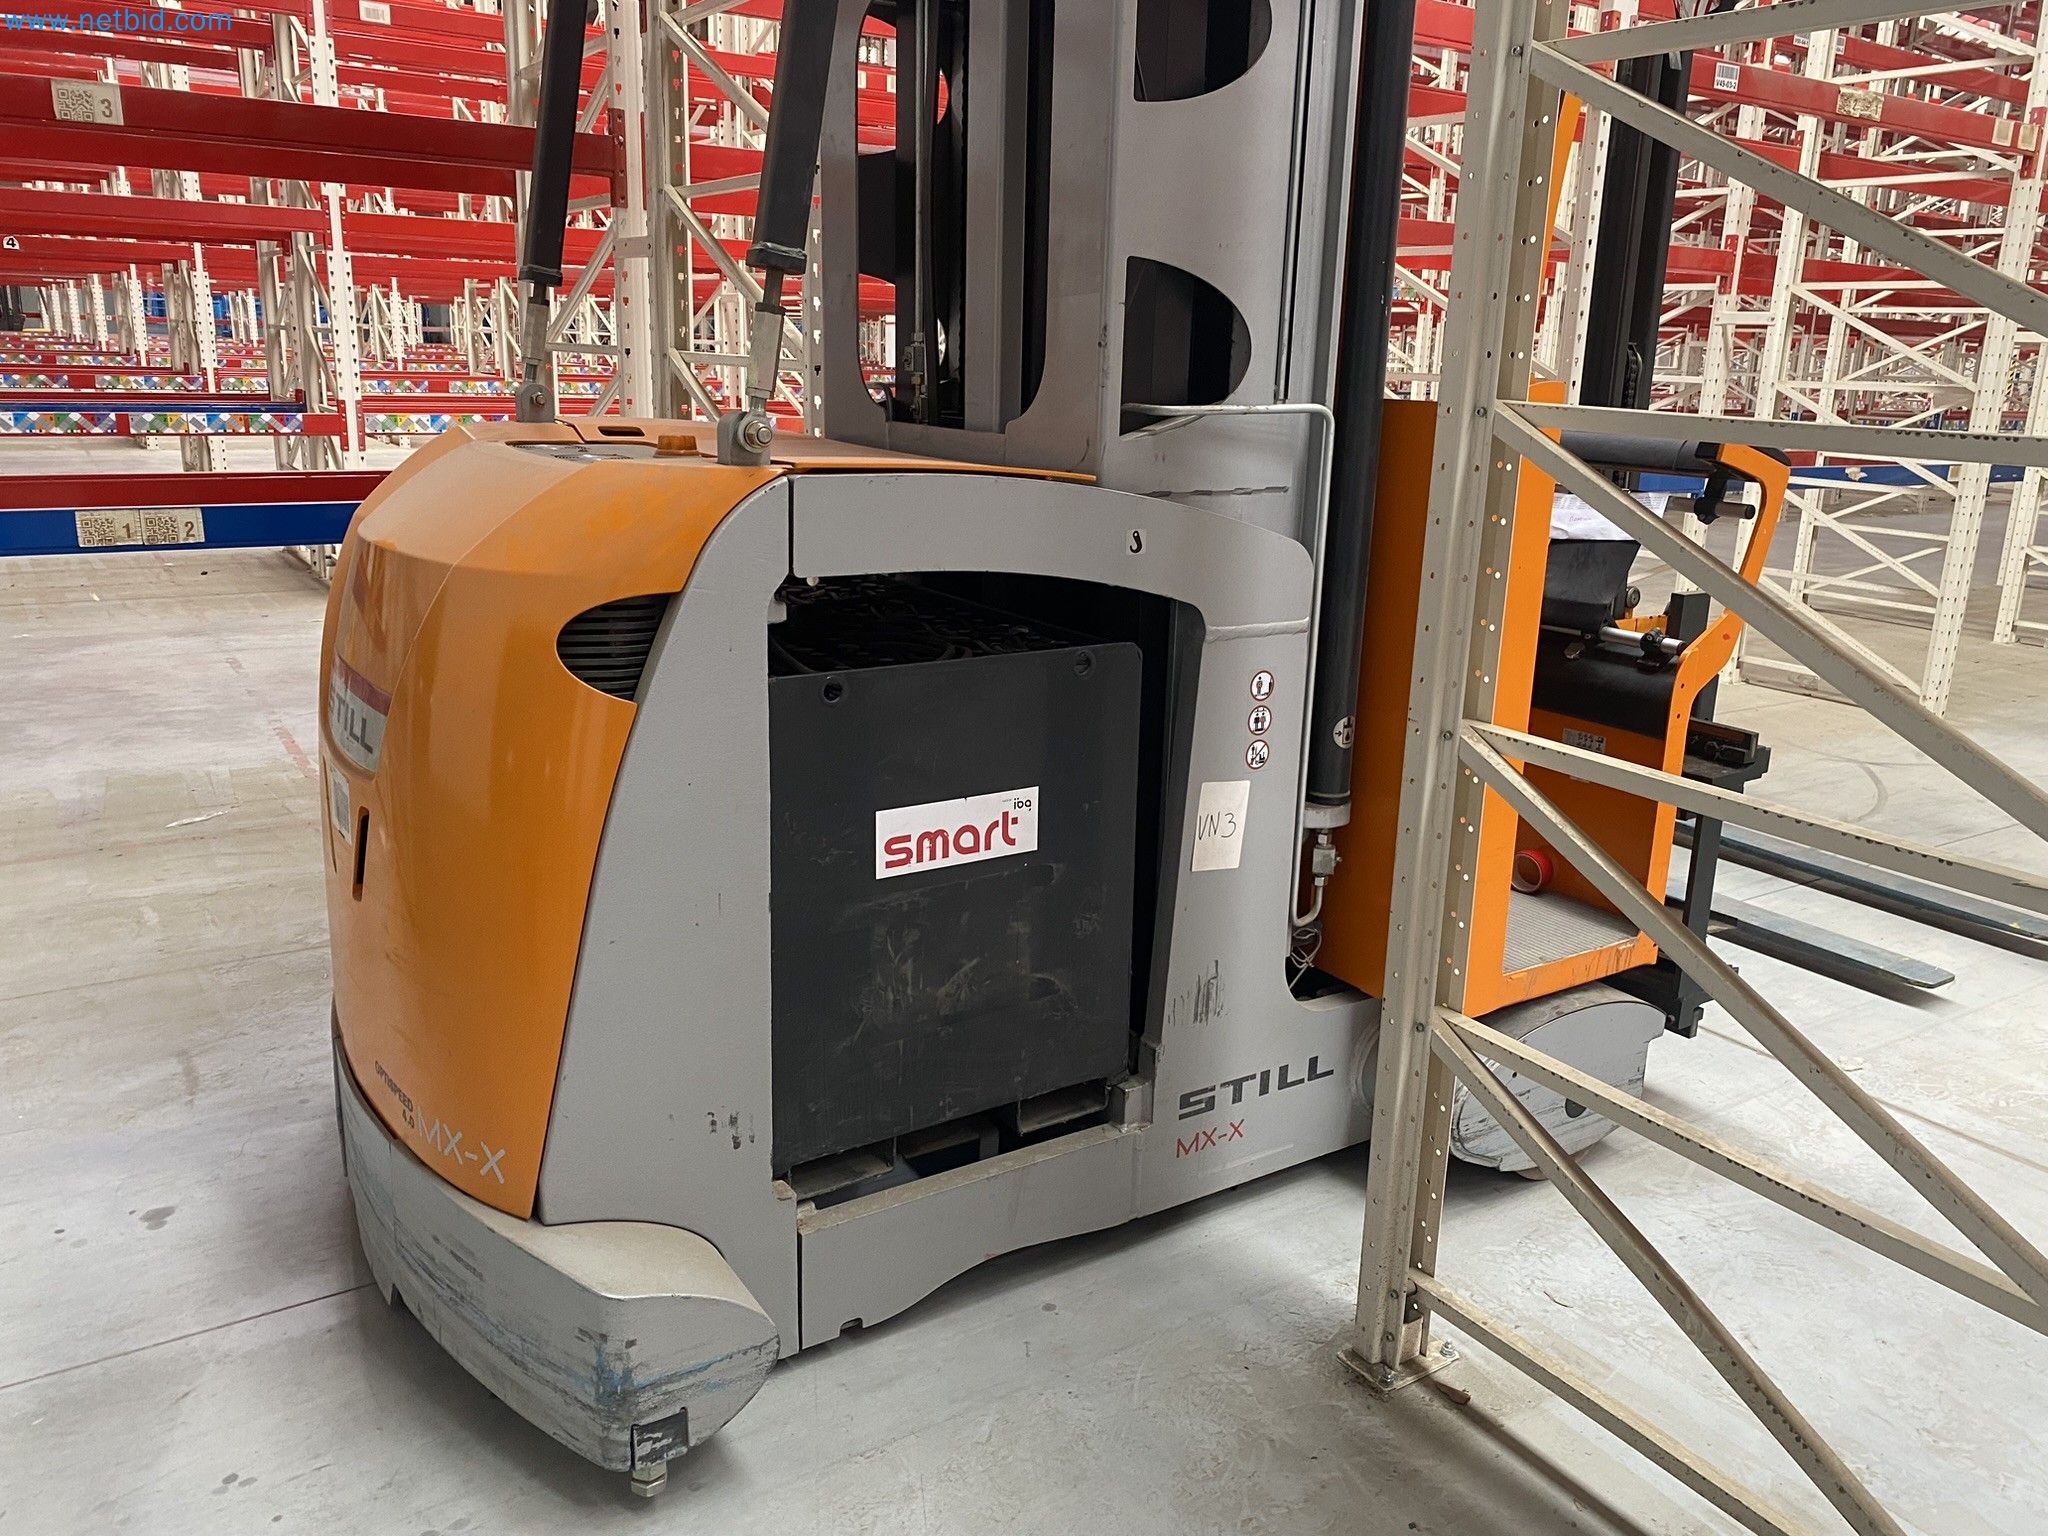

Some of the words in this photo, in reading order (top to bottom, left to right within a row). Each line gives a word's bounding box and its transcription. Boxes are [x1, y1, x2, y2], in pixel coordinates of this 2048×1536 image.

[100, 98, 113, 118] 3
[6, 237, 17, 248] 4
[122, 522, 132, 539] 1
[184, 521, 195, 538] 2
[884, 811, 1019, 869] smart
[1178, 1055, 1334, 1121] STILL
[417, 1105, 506, 1185] MX-X
[1176, 1118, 1245, 1159] MX-X
